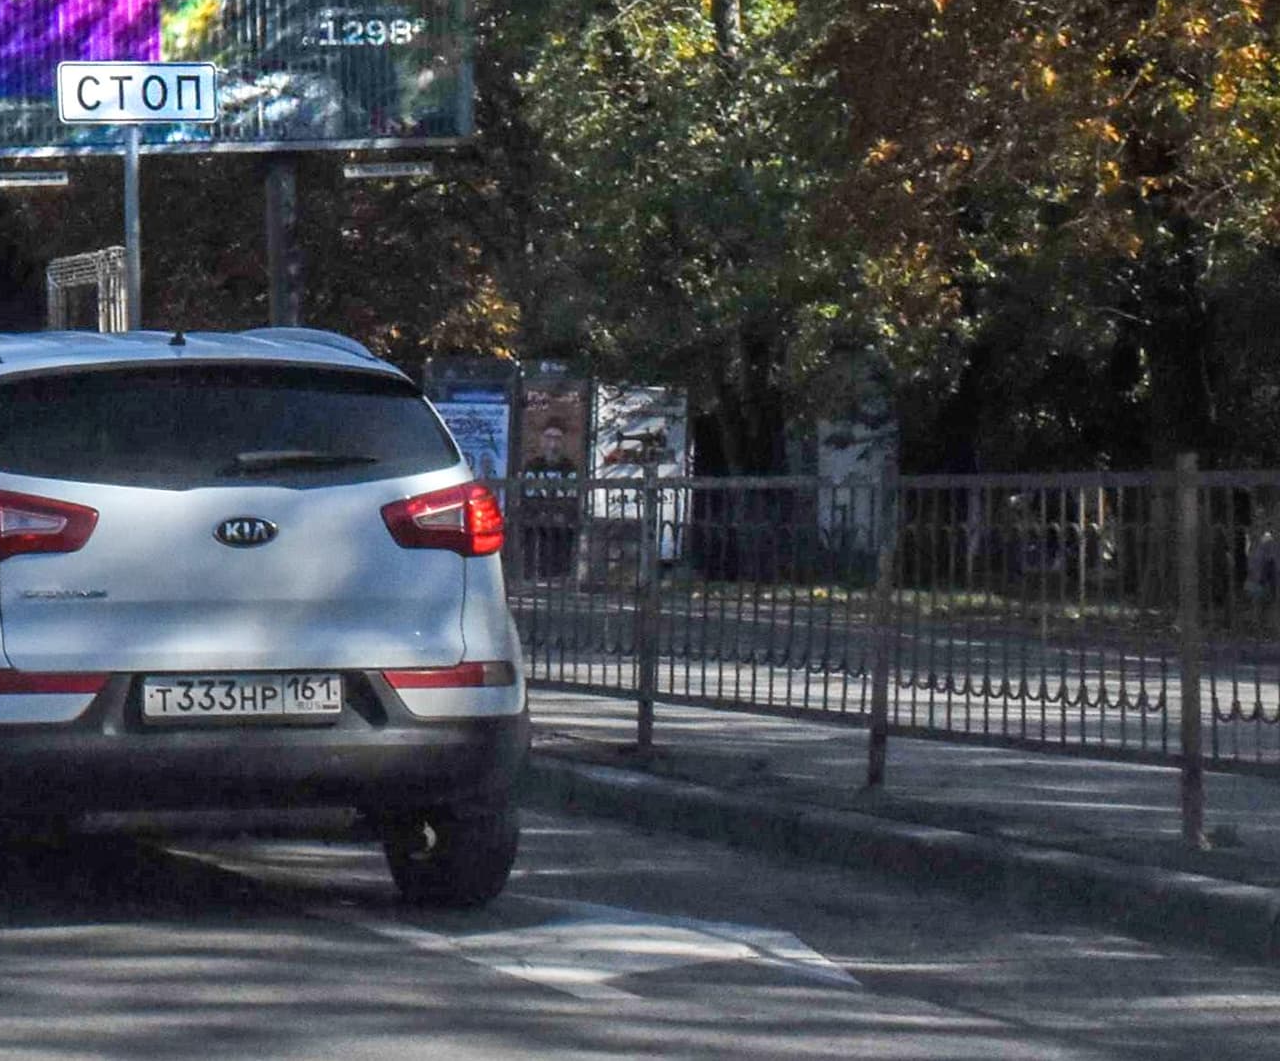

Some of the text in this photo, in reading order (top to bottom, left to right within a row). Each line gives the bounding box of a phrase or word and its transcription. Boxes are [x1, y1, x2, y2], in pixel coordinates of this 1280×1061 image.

[77, 74, 201, 112] СТОП
[224, 522, 269, 539] KIA
[287, 676, 331, 701] 161
